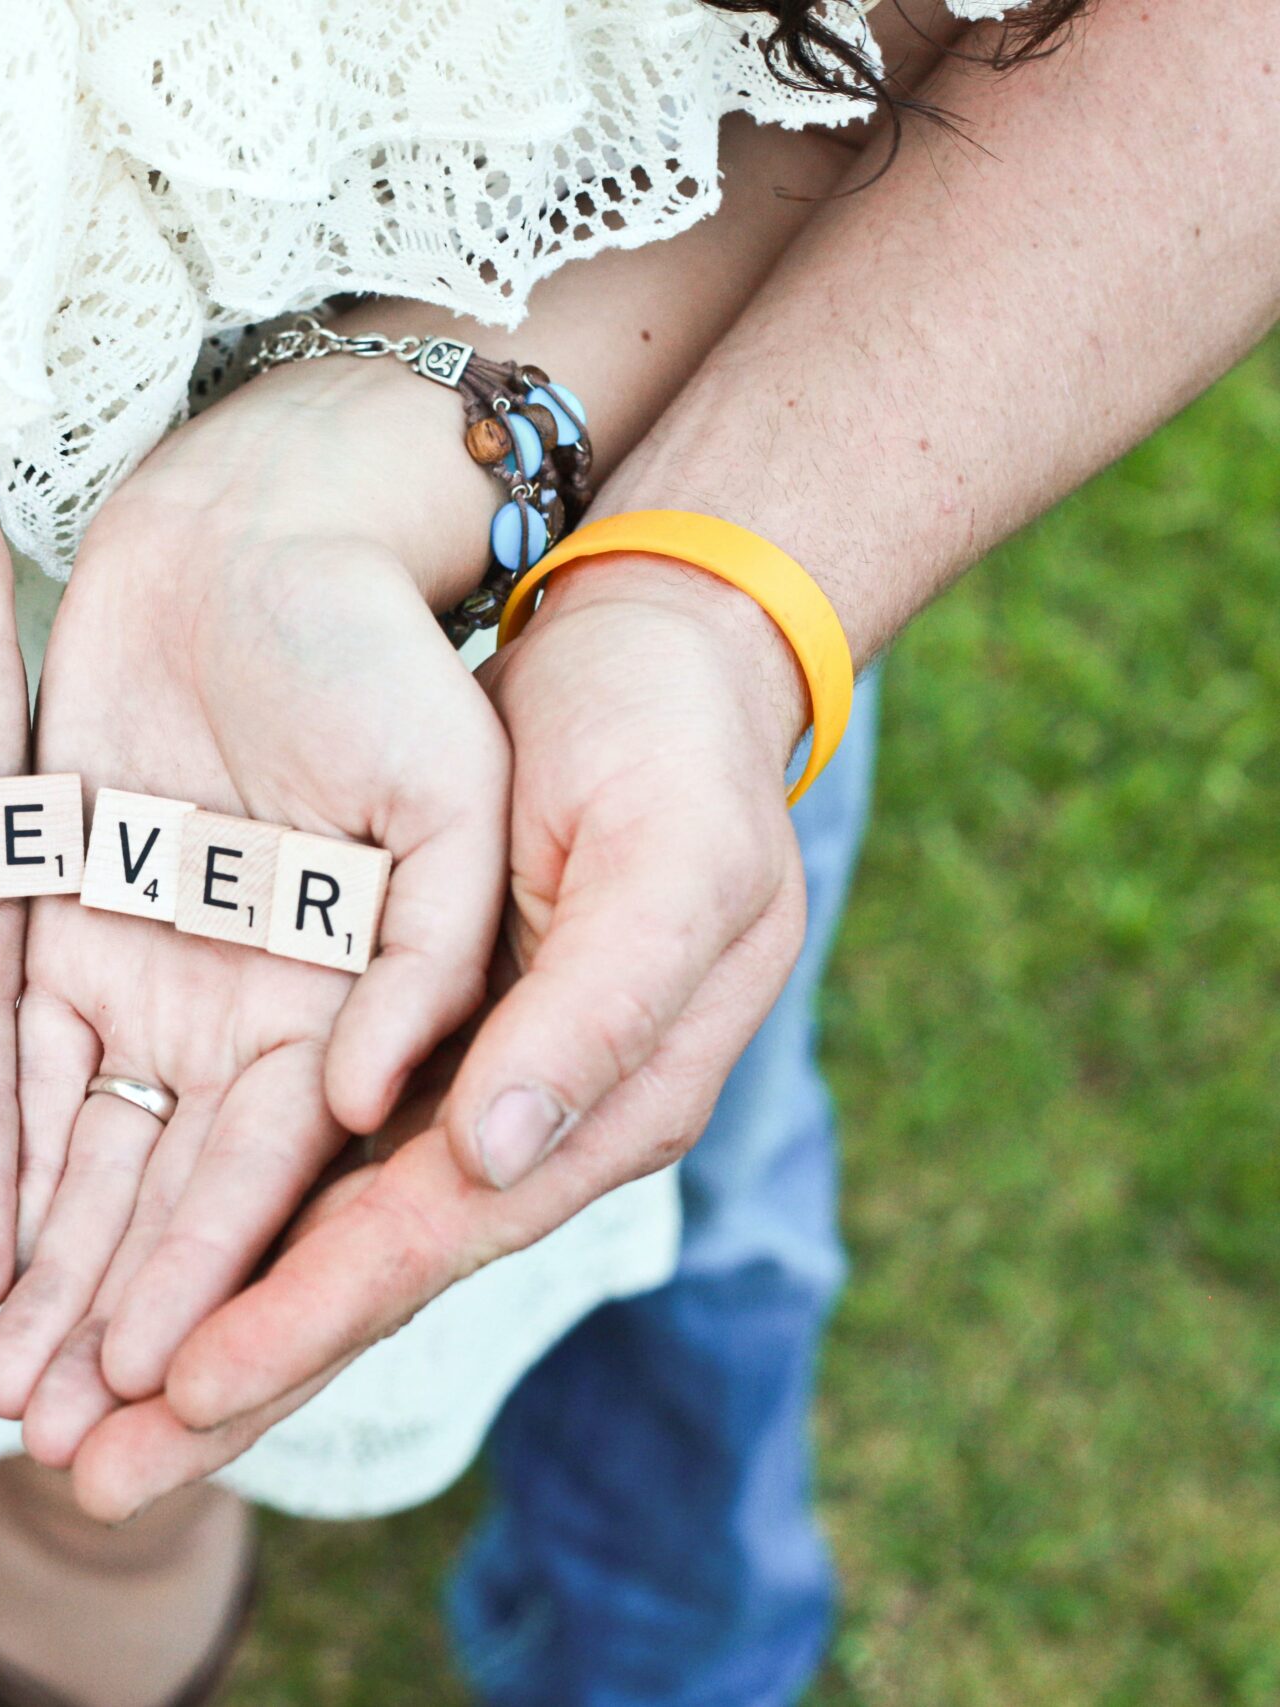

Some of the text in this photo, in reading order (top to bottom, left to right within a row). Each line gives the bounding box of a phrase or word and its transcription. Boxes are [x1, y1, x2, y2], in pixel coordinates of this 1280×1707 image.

[53, 853, 65, 878] 1
[142, 878, 160, 903] 4
[246, 905, 256, 928] 1
[344, 932, 354, 955] 1
